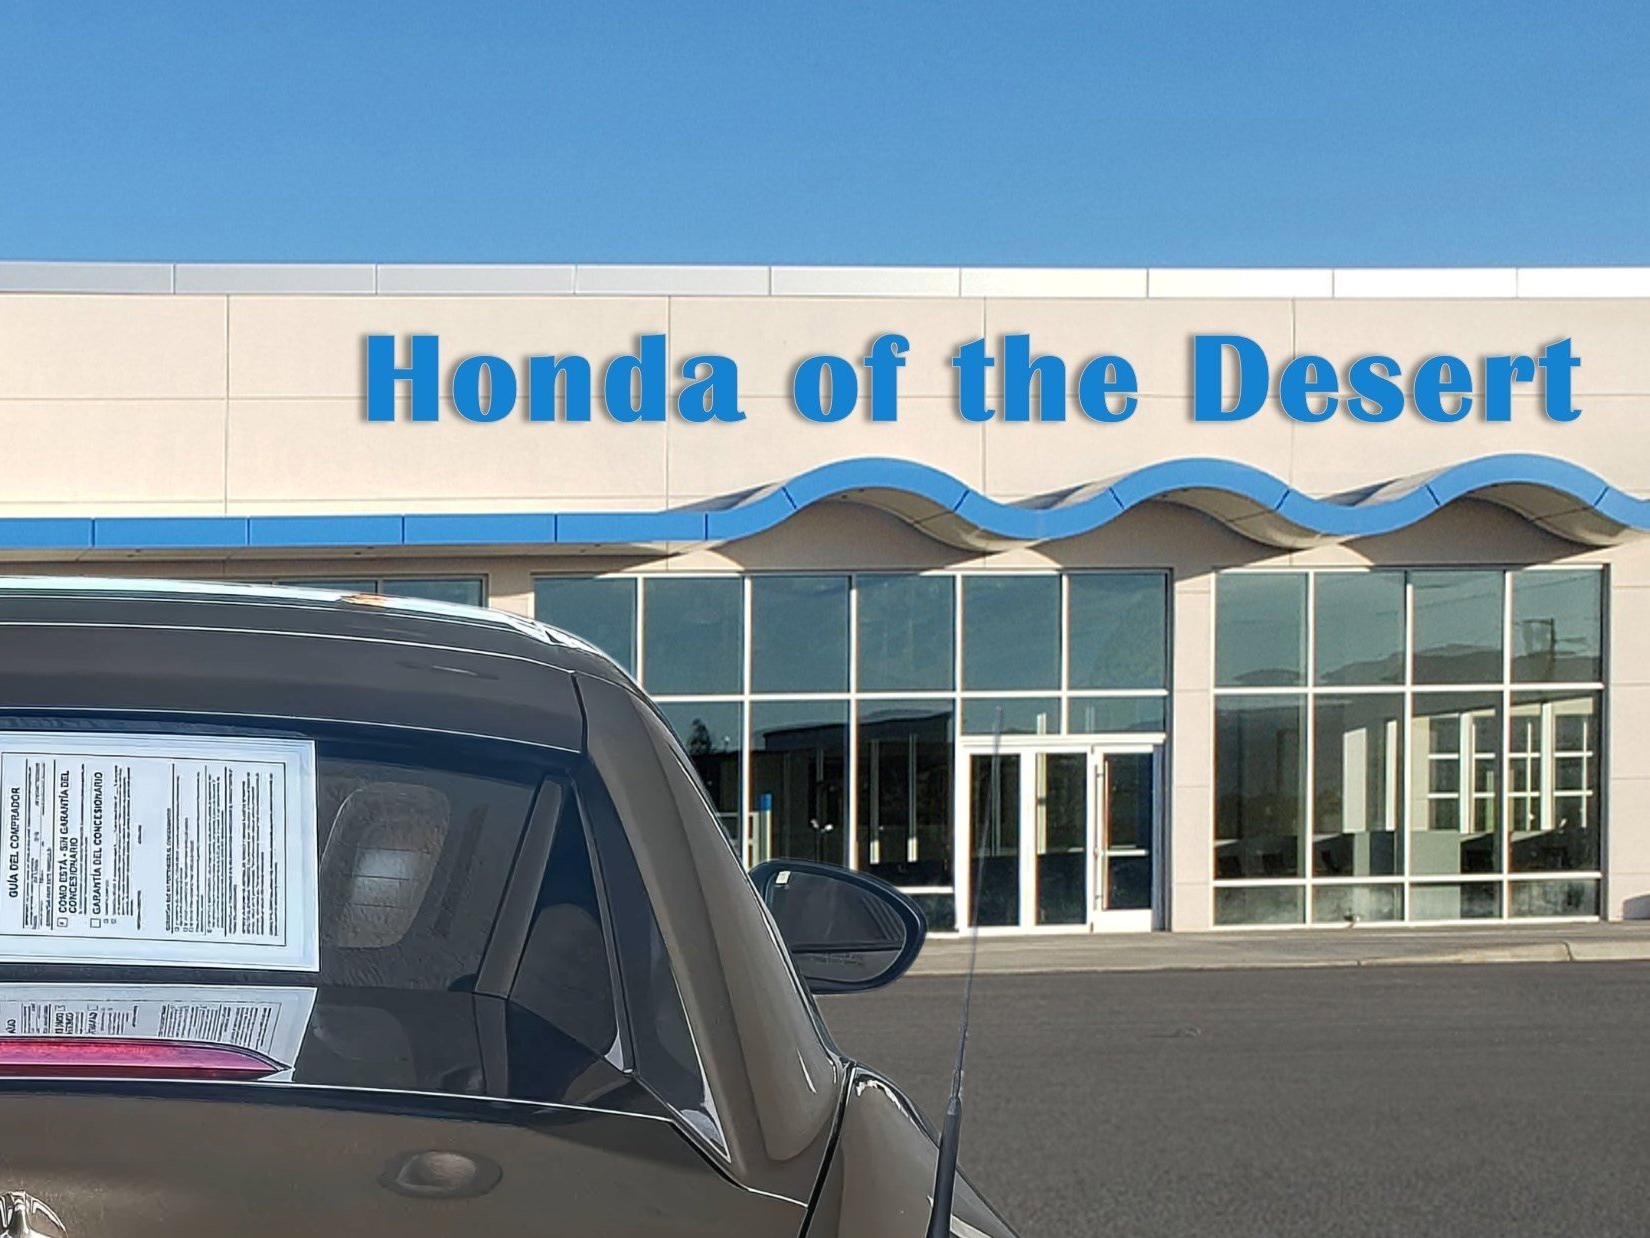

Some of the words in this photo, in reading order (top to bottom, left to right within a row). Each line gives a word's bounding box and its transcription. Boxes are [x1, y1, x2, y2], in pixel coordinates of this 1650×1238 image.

[363, 333, 746, 423] Honda
[794, 333, 912, 423] of
[950, 333, 1141, 423] the
[1193, 333, 1582, 423] Desert
[60, 770, 69, 788] DEL
[10, 788, 20, 849] COMPRADOR
[58, 789, 69, 834] GARANTÍA
[93, 772, 102, 845] CONCESIONARIO
[60, 837, 68, 851] SIN
[93, 848, 102, 865] DEL
[10, 852, 19, 870] DEL
[58, 859, 68, 882] ESTÁ
[7, 874, 18, 898] GUÍA
[69, 838, 78, 914] CONCESIONARIO
[58, 885, 67, 913] COMO
[90, 867, 101, 914] GARANTÍA
